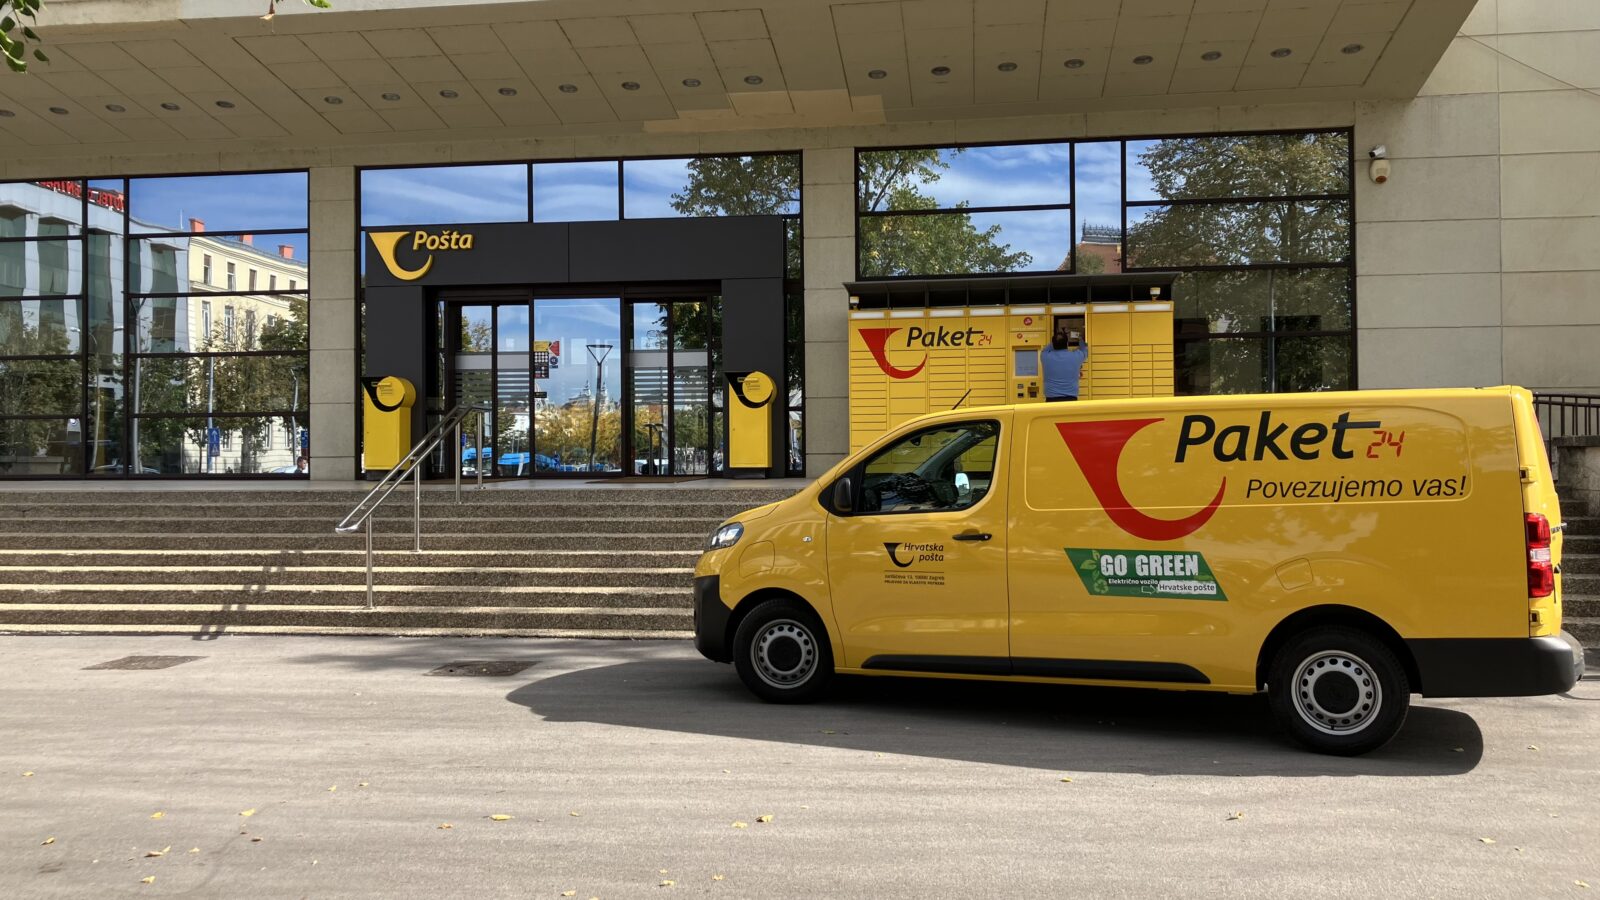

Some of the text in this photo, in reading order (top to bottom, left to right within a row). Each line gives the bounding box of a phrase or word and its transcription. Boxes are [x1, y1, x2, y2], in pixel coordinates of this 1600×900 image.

[412, 230, 474, 251] Pošta
[906, 325, 993, 347] Paket 24
[1174, 410, 1405, 463] Paket 24
[1246, 475, 1467, 503] Povezujemo vas!
[904, 542, 944, 551] Hrvatska
[919, 553, 944, 562] pošta
[1100, 554, 1199, 577] GO GREEN
